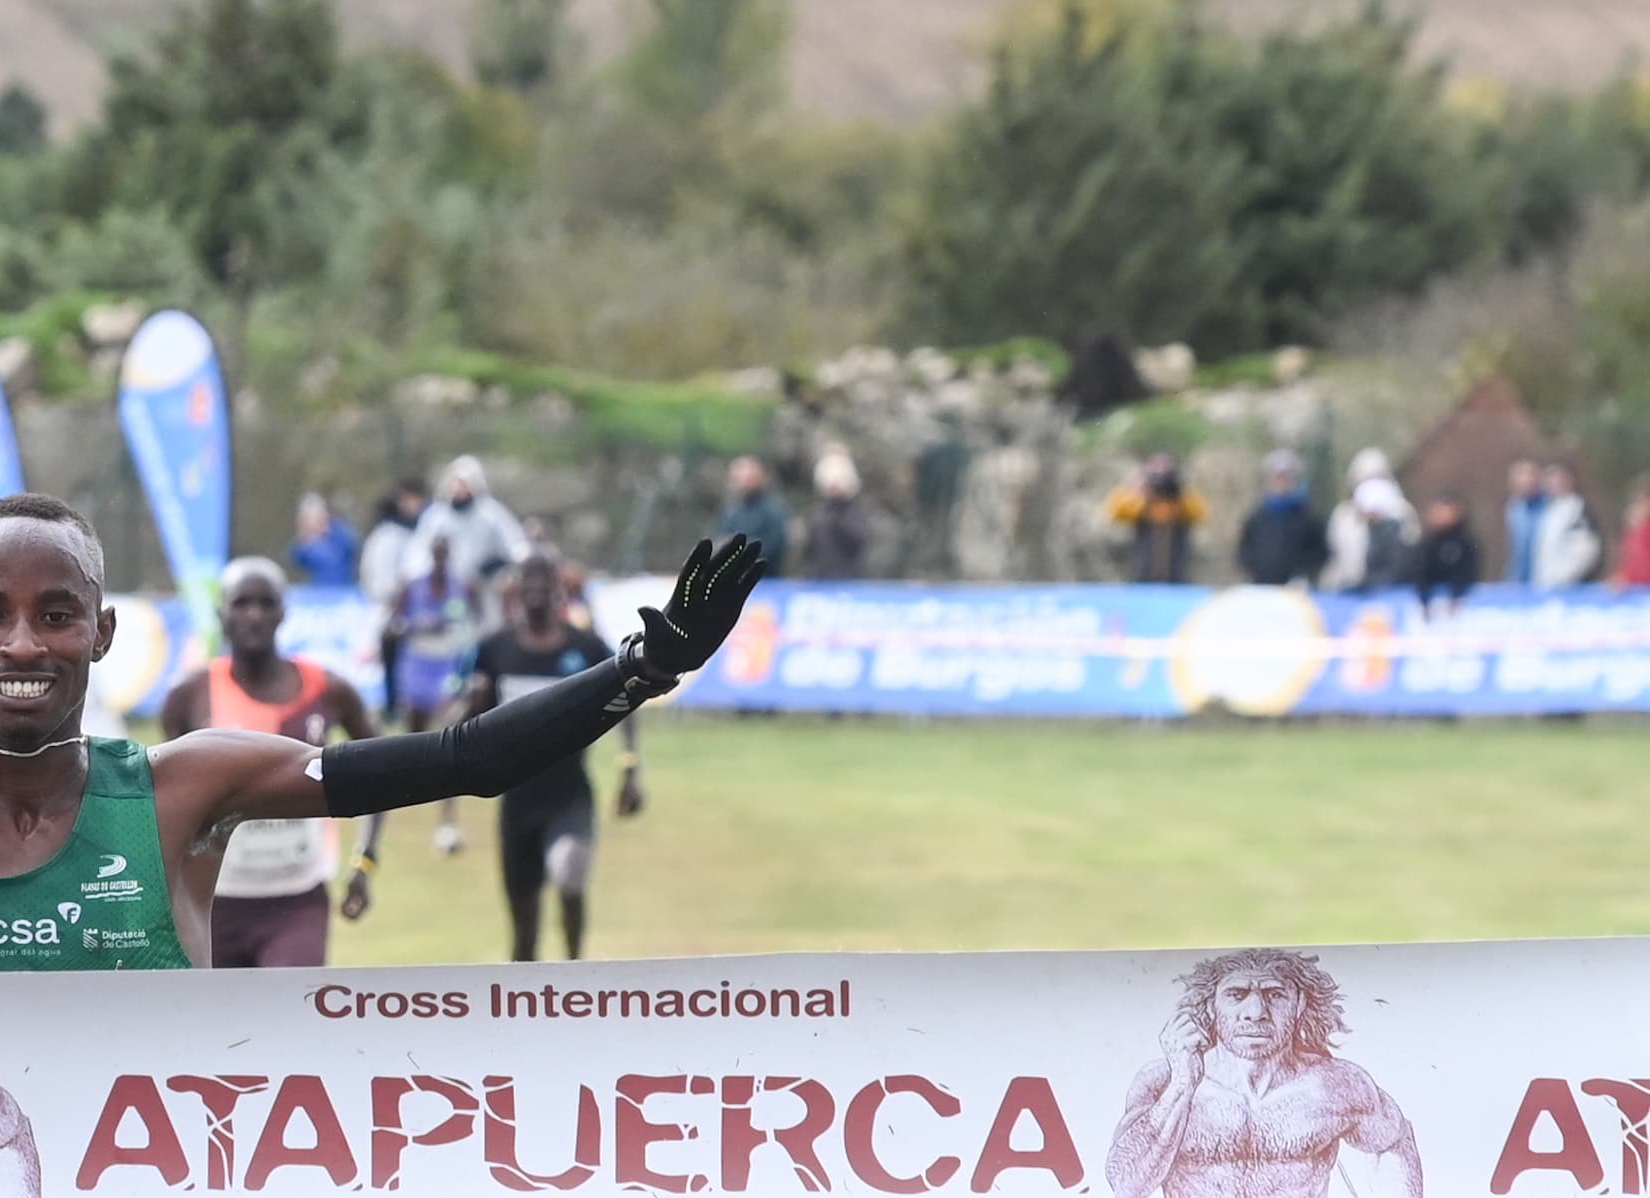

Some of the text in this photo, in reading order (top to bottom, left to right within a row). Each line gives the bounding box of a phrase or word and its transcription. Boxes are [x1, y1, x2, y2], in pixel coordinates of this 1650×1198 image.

[314, 980, 851, 1019] Cross Internacional
[76, 1073, 1090, 1195] ATAPUERCA
